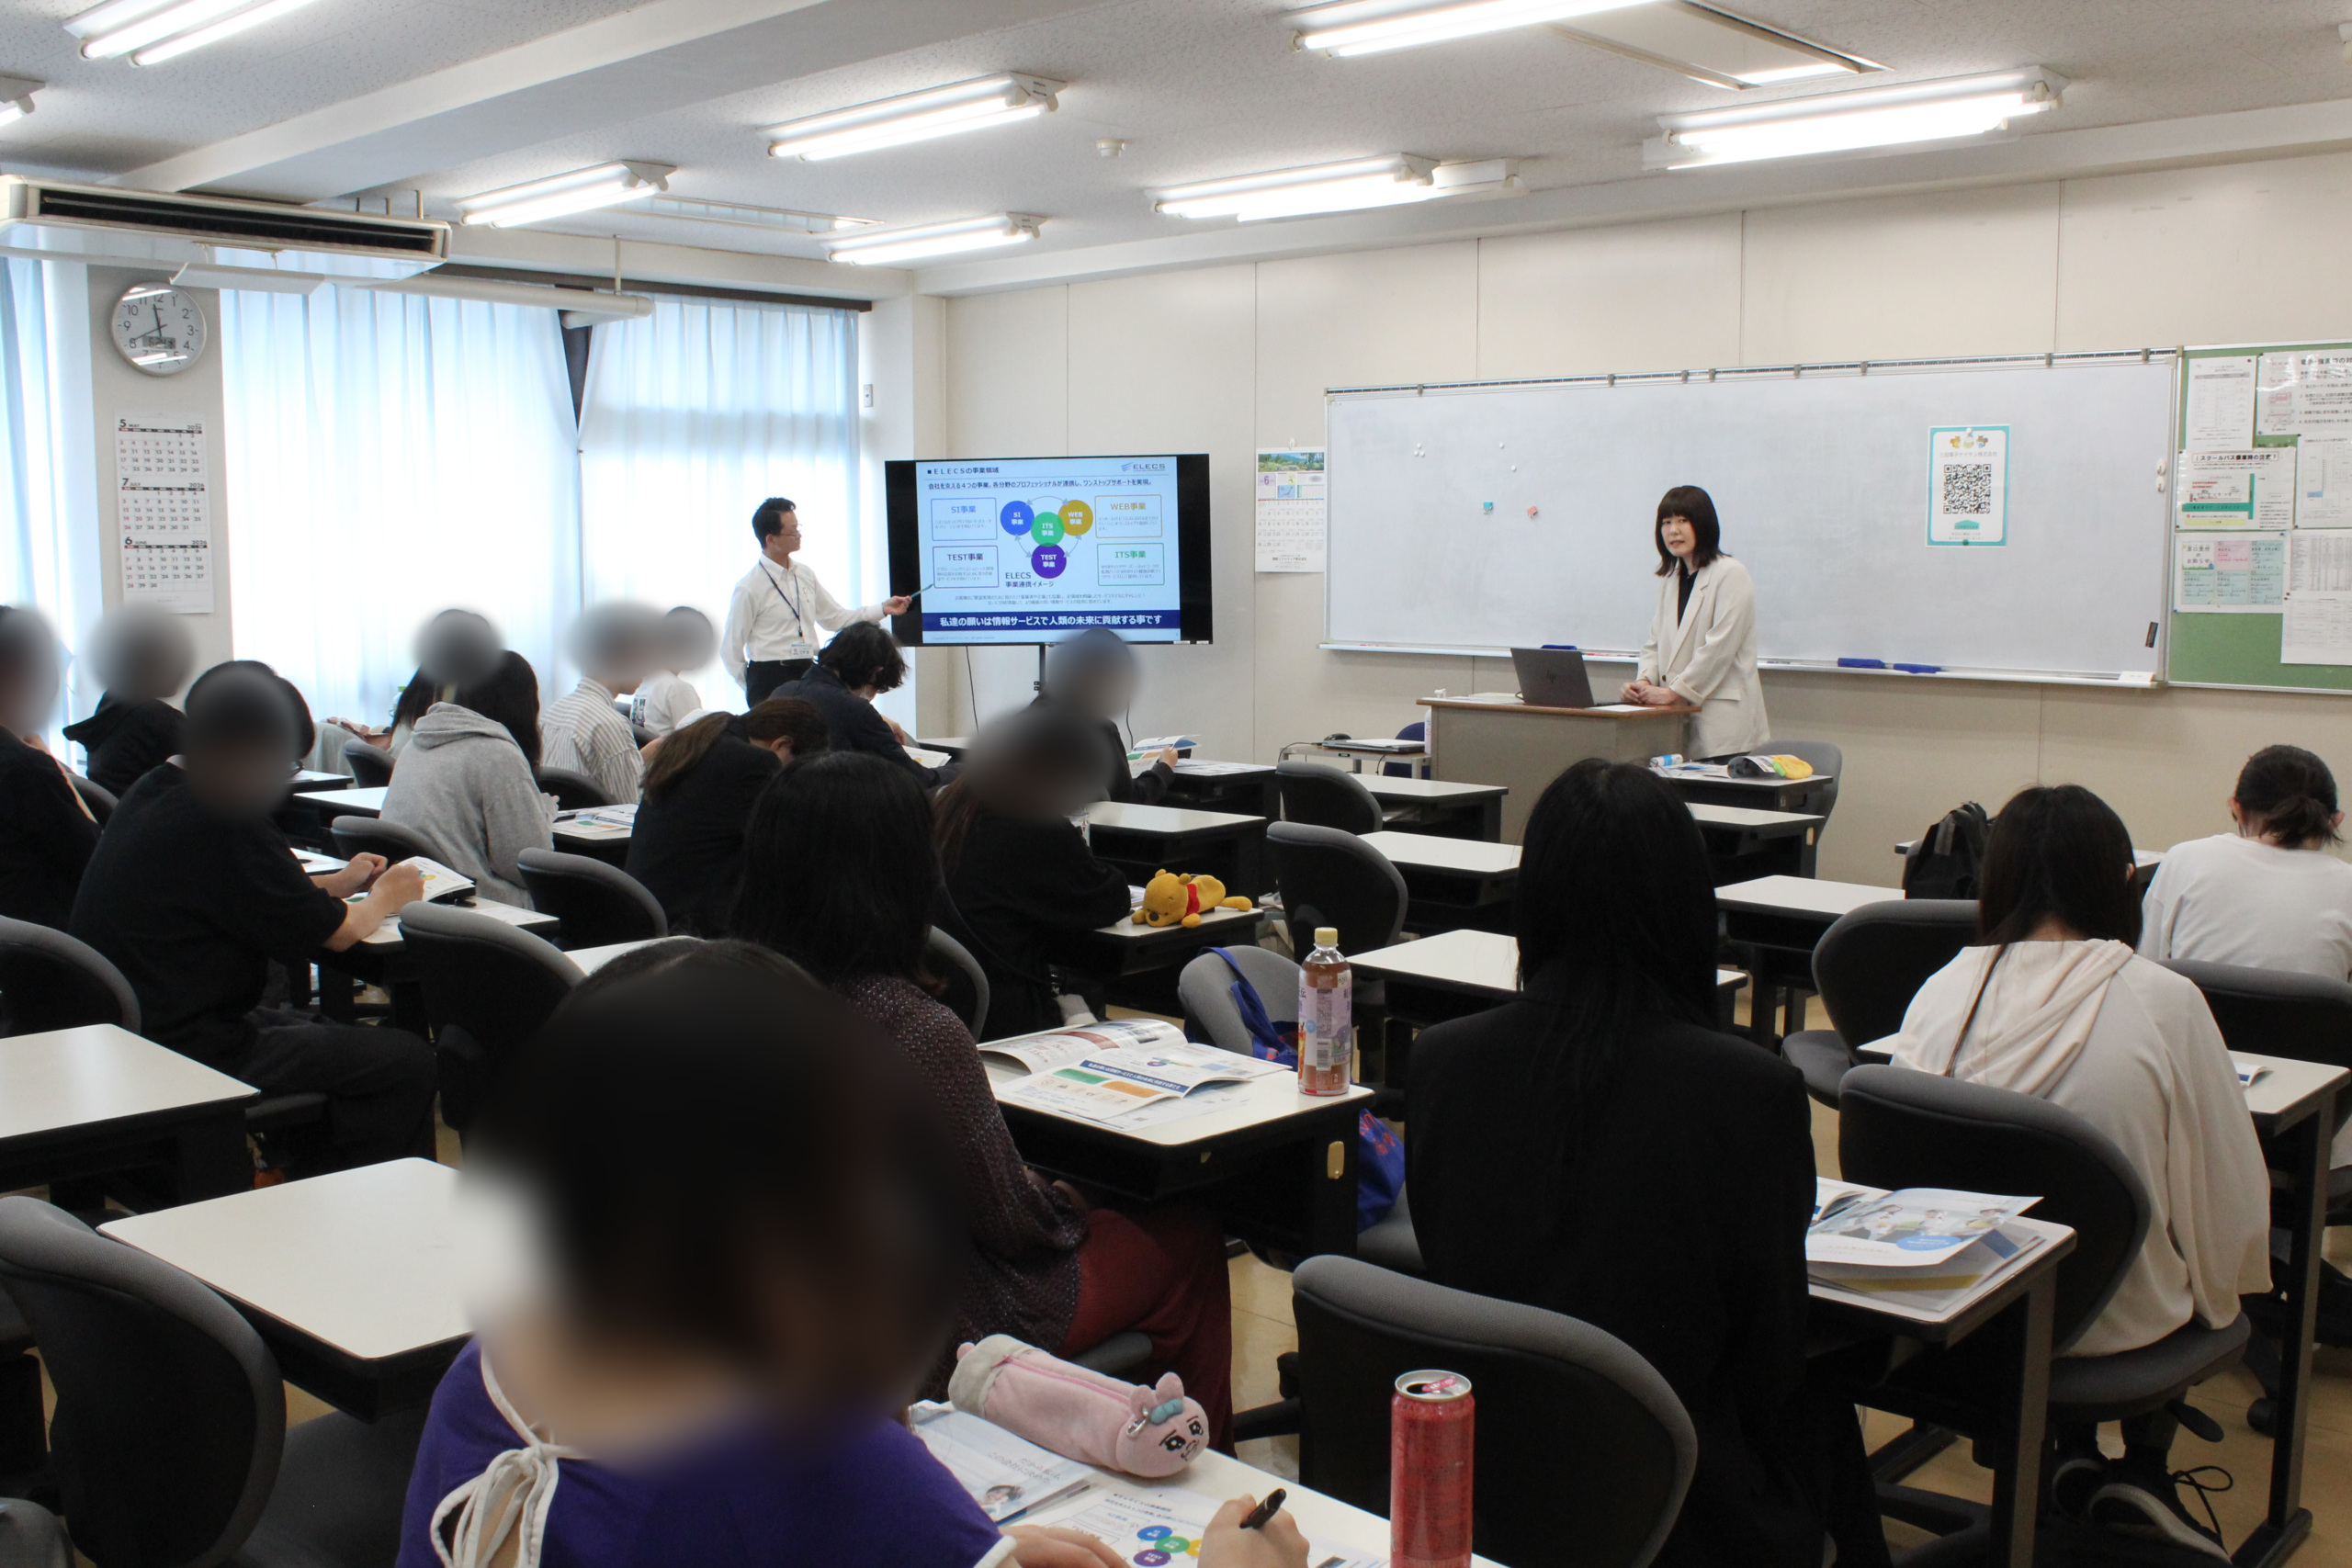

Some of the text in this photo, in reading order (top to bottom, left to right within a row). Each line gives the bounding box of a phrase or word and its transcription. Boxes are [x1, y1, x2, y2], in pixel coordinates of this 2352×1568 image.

[173, 296, 175, 306] 1
[128, 305, 139, 316] 10
[182, 309, 189, 319] 2
[123, 321, 130, 331] 9
[187, 325, 195, 335] 3
[130, 338, 136, 348] 8
[183, 341, 189, 350] 4
[119, 419, 126, 427] 5
[122, 478, 130, 486] 7
[1264, 476, 1269, 485] 6
[951, 505, 976, 513] SI事業
[125, 536, 132, 545] 6
[947, 553, 983, 561] TEST事業
